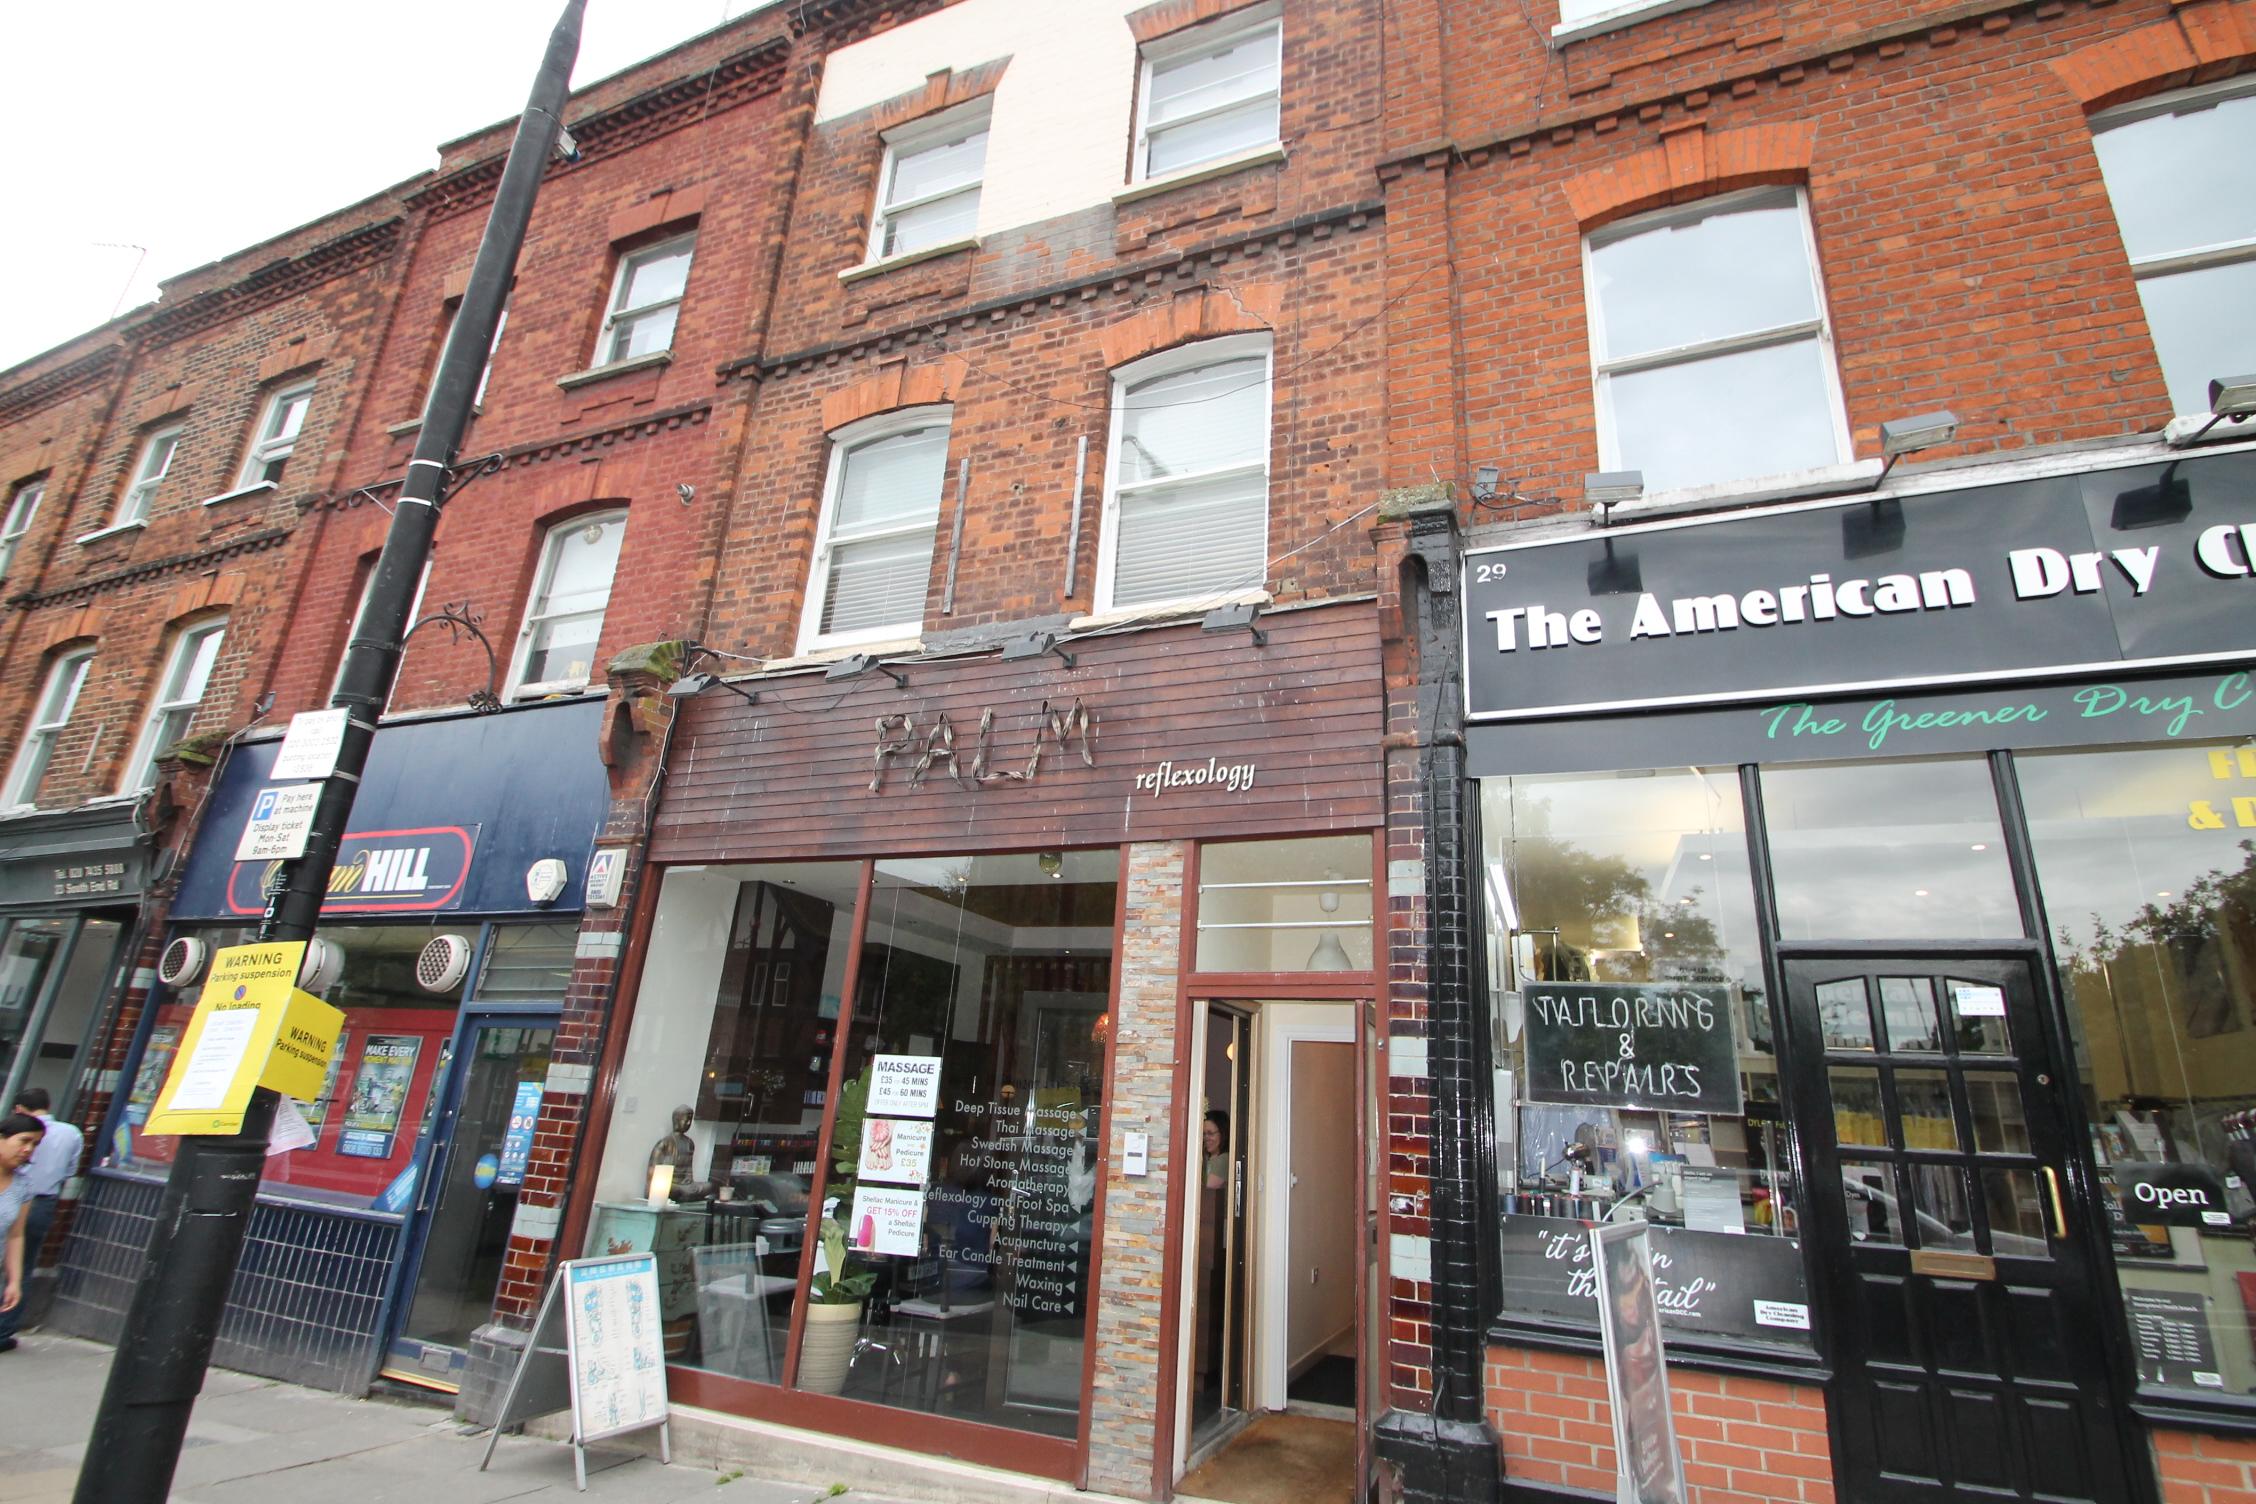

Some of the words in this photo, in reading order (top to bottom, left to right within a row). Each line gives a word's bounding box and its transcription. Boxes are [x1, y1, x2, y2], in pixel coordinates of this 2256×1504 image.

[1476, 562, 1507, 585] 29
[1486, 605, 1603, 653] The
[1630, 567, 1977, 641] American
[2008, 546, 2160, 600] Dry
[1760, 702, 1847, 741] The
[1861, 697, 2049, 751] Greener
[2073, 684, 2204, 737] Dry
[868, 696, 1096, 794] PALM
[1136, 757, 1257, 798] reflexology
[283, 793, 295, 804] Pay
[297, 792, 312, 801] here
[274, 807, 282, 815] at
[284, 804, 313, 813] machine
[2188, 800, 2226, 831] &
[253, 822, 279, 833] Display
[282, 821, 303, 830] ticket
[258, 833, 290, 843] Mon-Sat
[252, 846, 287, 856] 9am-6pm
[361, 847, 431, 893] HILL
[225, 952, 283, 968] WARNING
[211, 972, 239, 983] Parking
[239, 968, 292, 980] suspension
[215, 1002, 227, 1012] No
[1533, 995, 1714, 1032] TAILORING
[290, 1025, 328, 1053] WARNING
[1619, 1032, 1636, 1059] &
[275, 1037, 300, 1059] Parking
[299, 1048, 328, 1069] suspension
[365, 1044, 389, 1057] MAKE
[388, 1045, 417, 1057] EVERY
[877, 1061, 936, 1075] MASSAGE
[1560, 1058, 1701, 1098] REPAIRS
[880, 1075, 893, 1085] £35
[902, 1076, 911, 1086] 45
[911, 1077, 929, 1087] MINS
[879, 1087, 892, 1096] £45
[900, 1088, 908, 1097] 60
[909, 1088, 927, 1098] MINS
[955, 1100, 984, 1117] Deep
[988, 1100, 1021, 1117] Tissue
[896, 1132, 927, 1143] Manicure
[996, 1119, 1019, 1135] Thai
[895, 1148, 924, 1157] Pedicure
[971, 1135, 1018, 1153] Swedish
[1021, 1139, 1074, 1160] Massage
[900, 1158, 917, 1168] £35
[960, 1153, 981, 1168] Hot
[983, 1155, 1016, 1170] Stone
[1019, 1159, 1071, 1178] Massage
[986, 1173, 1070, 1199] Aromatherapy
[2134, 1182, 2209, 1209] Open
[862, 1195, 883, 1204] Shellac
[885, 1196, 912, 1206] Manicure
[990, 1194, 1014, 1209] and
[1017, 1195, 1043, 1211] Foot
[1046, 1198, 1069, 1215] Spa
[866, 1206, 882, 1216] GET
[883, 1207, 900, 1218] 15%
[901, 1209, 918, 1218] OFF
[967, 1209, 1016, 1231] Cupping
[1020, 1214, 1069, 1236] Therapy
[888, 1228, 915, 1238] Pedicure
[893, 1220, 917, 1228] Shellac
[993, 1232, 1067, 1253] Acupuncture
[938, 1244, 958, 1259] Ear
[961, 1247, 1003, 1266] Candle
[1006, 1252, 1066, 1273] Treatment
[1016, 1272, 1063, 1297] Waxing
[1002, 1292, 1028, 1309] Nail
[1031, 1296, 1062, 1313] Care
